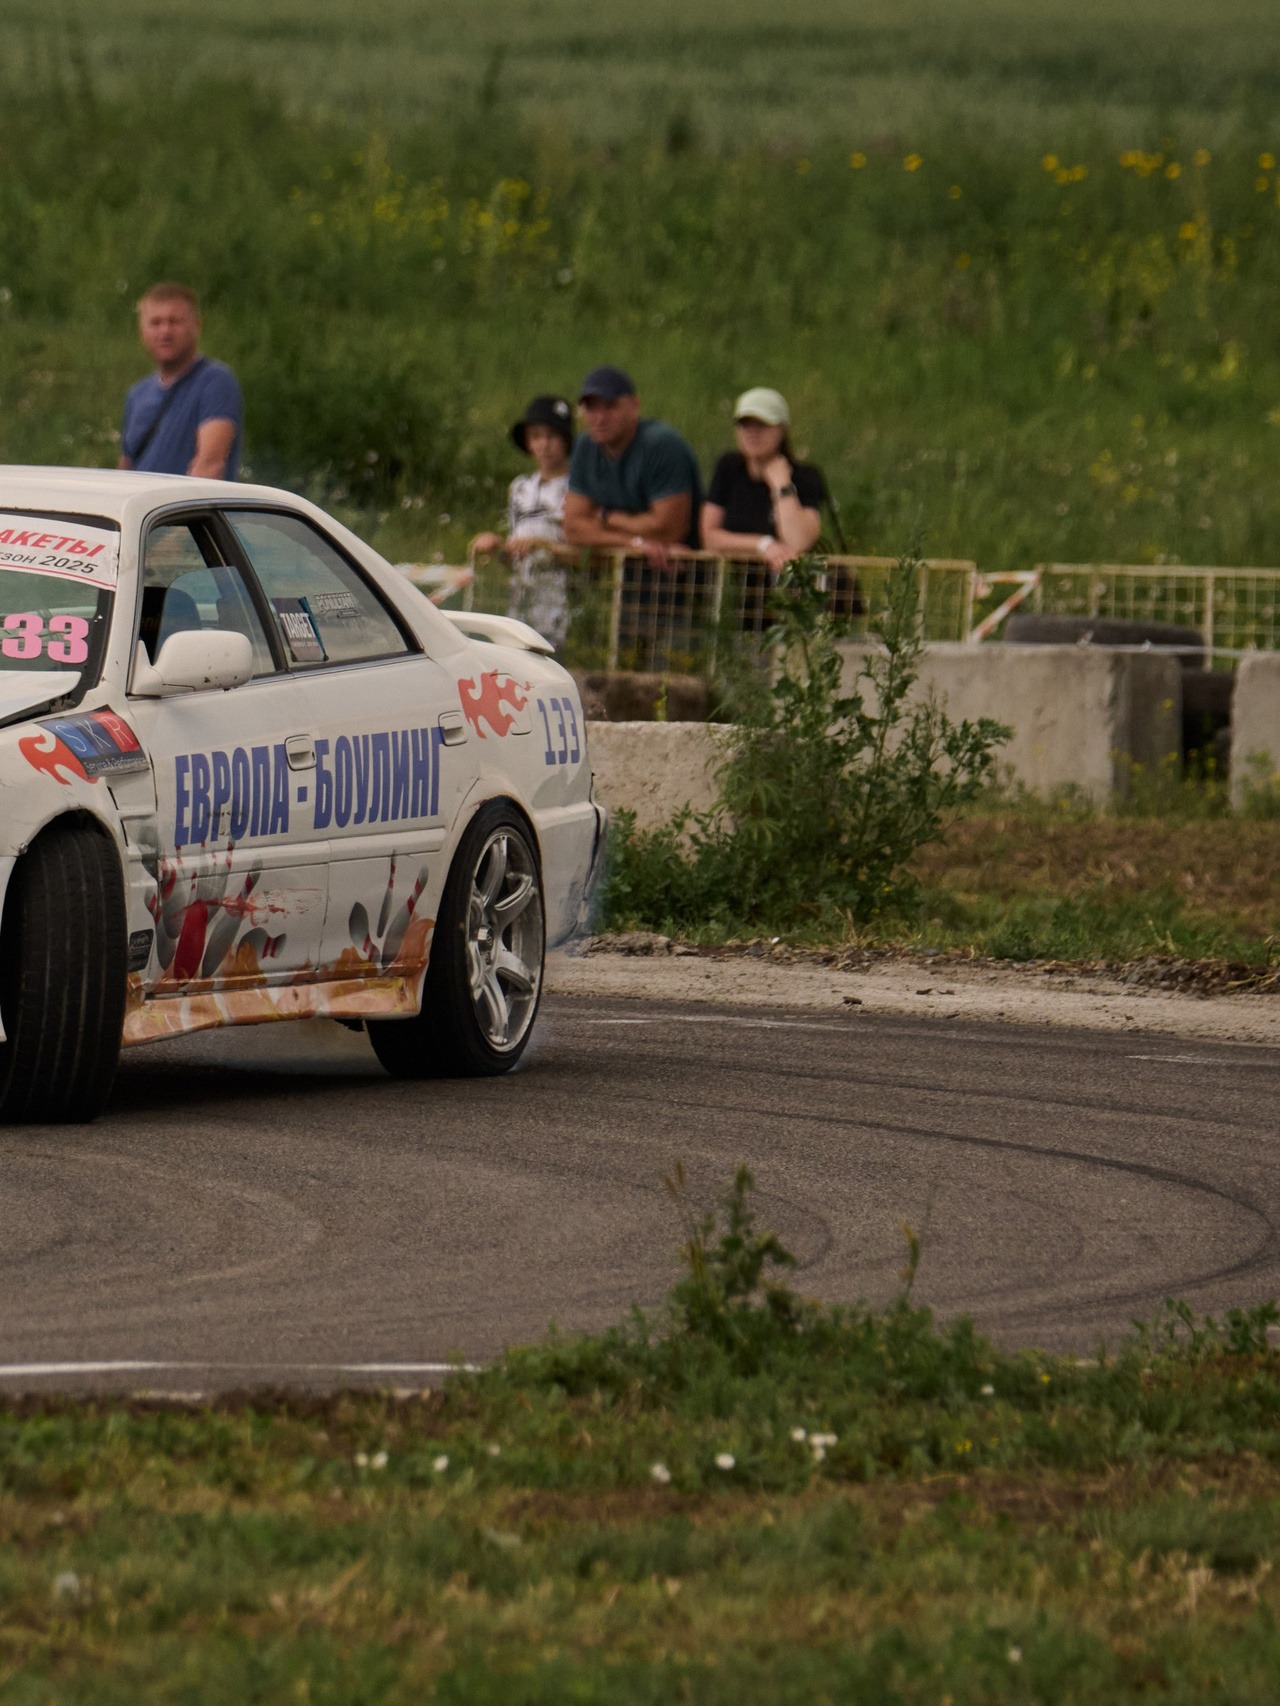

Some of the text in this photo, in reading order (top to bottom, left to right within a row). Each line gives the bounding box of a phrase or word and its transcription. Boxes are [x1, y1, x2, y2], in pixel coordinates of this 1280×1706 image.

[38, 555, 99, 574] 2025
[279, 613, 317, 638] TARGET
[55, 716, 134, 752] SKR
[536, 697, 581, 766] 133
